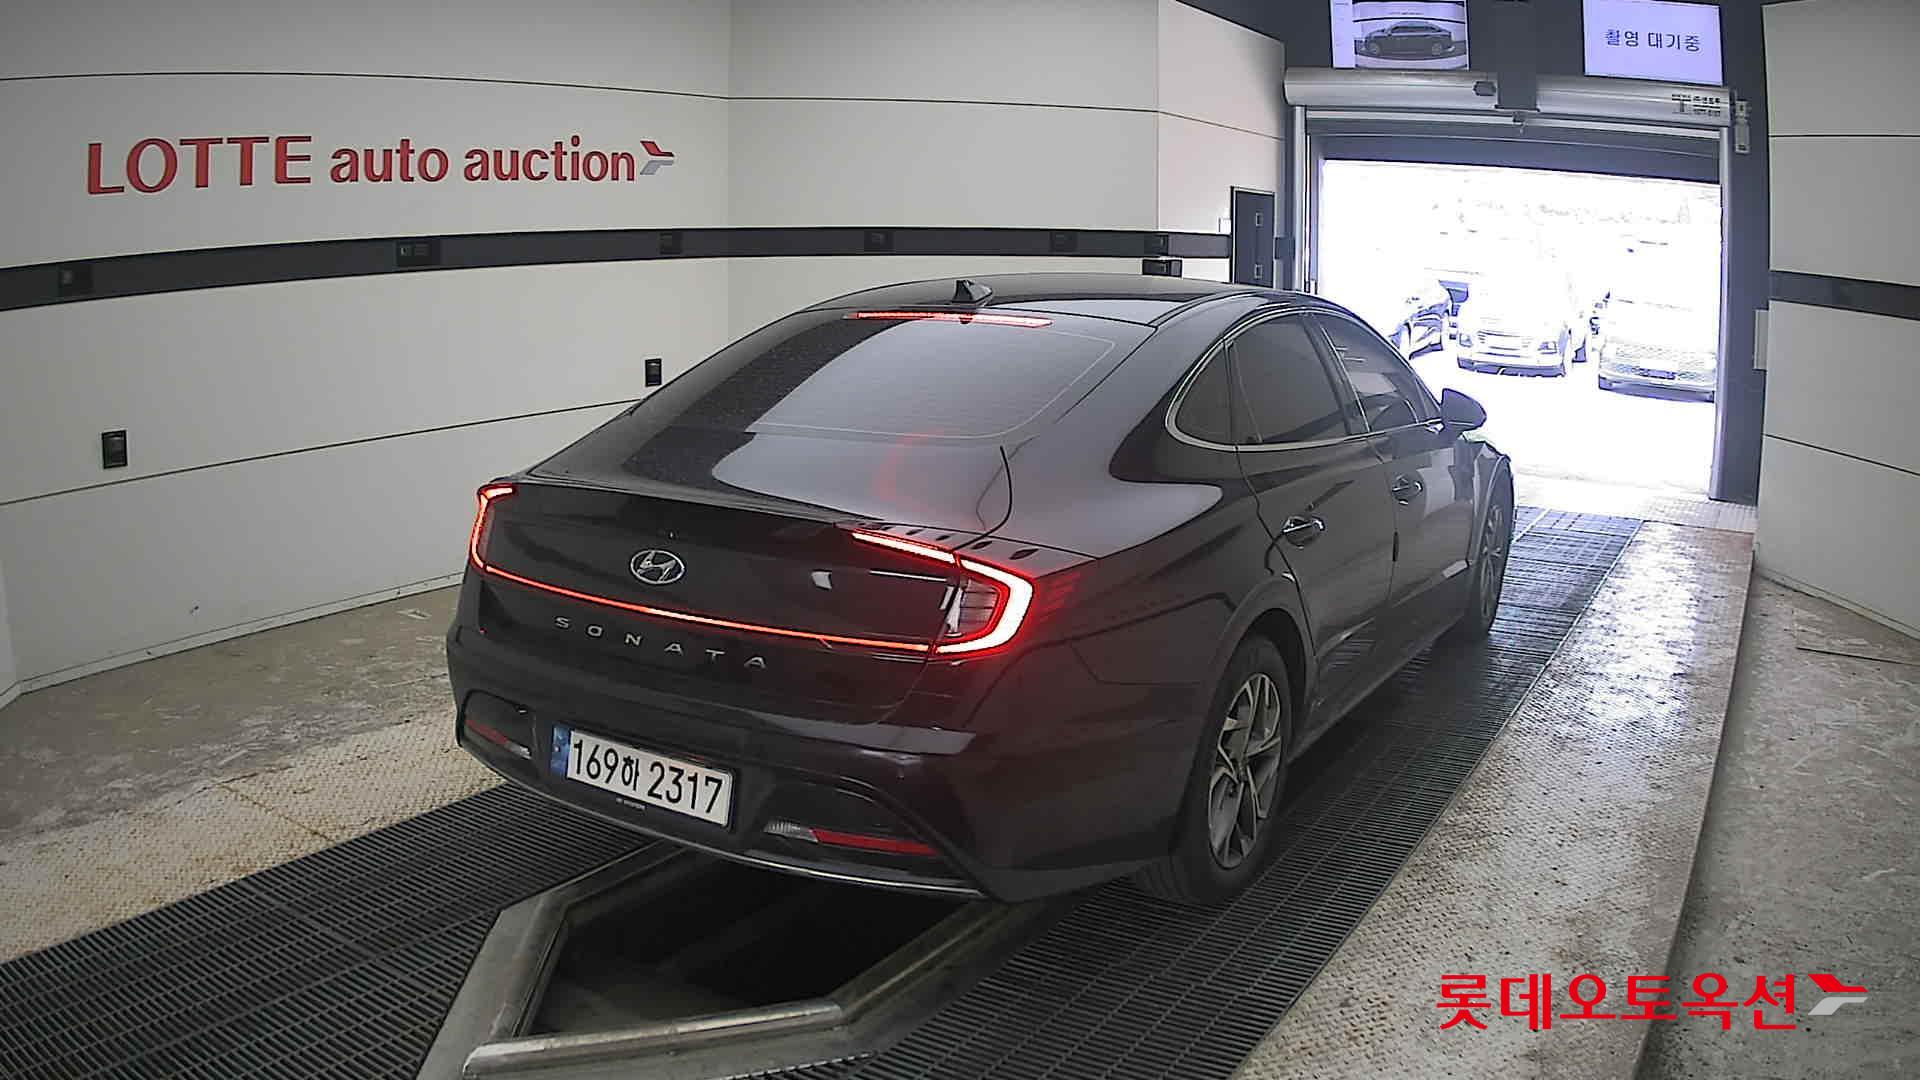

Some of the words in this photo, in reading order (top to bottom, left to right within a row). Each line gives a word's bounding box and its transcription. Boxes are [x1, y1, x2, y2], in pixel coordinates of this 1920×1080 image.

[1647, 32, 1701, 52] 대기중
[87, 135, 312, 194] LOTTE
[330, 139, 449, 183] auto
[464, 135, 636, 182] auction
[555, 616, 766, 669] SONATA
[573, 739, 640, 791] 169하
[648, 762, 723, 814] 2317
